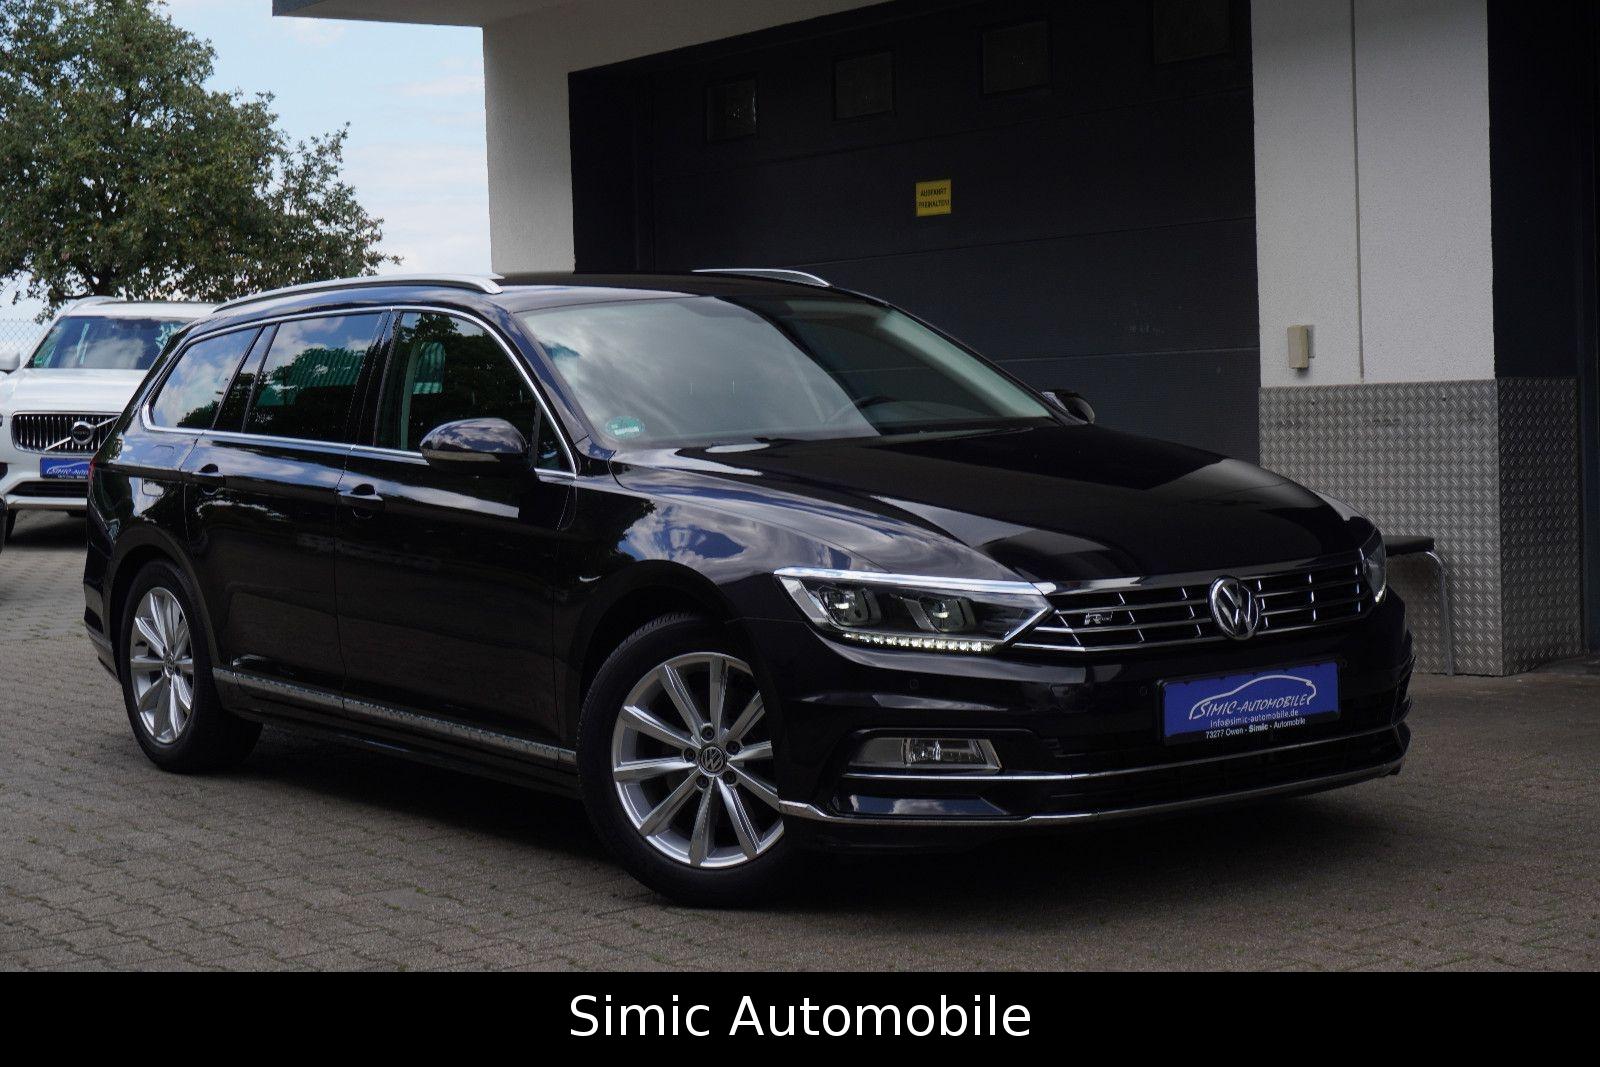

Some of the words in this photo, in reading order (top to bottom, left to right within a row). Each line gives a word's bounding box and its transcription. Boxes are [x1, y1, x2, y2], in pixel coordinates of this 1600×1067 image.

[1199, 693, 1308, 717] SIMIC-AUTOMOBILE
[1205, 729, 1224, 740] 73277
[1225, 727, 1244, 737] Owen
[1248, 723, 1269, 733] Simic
[1273, 717, 1306, 729] Automobile
[1210, 708, 1299, 728] info@simic-automobile.de
